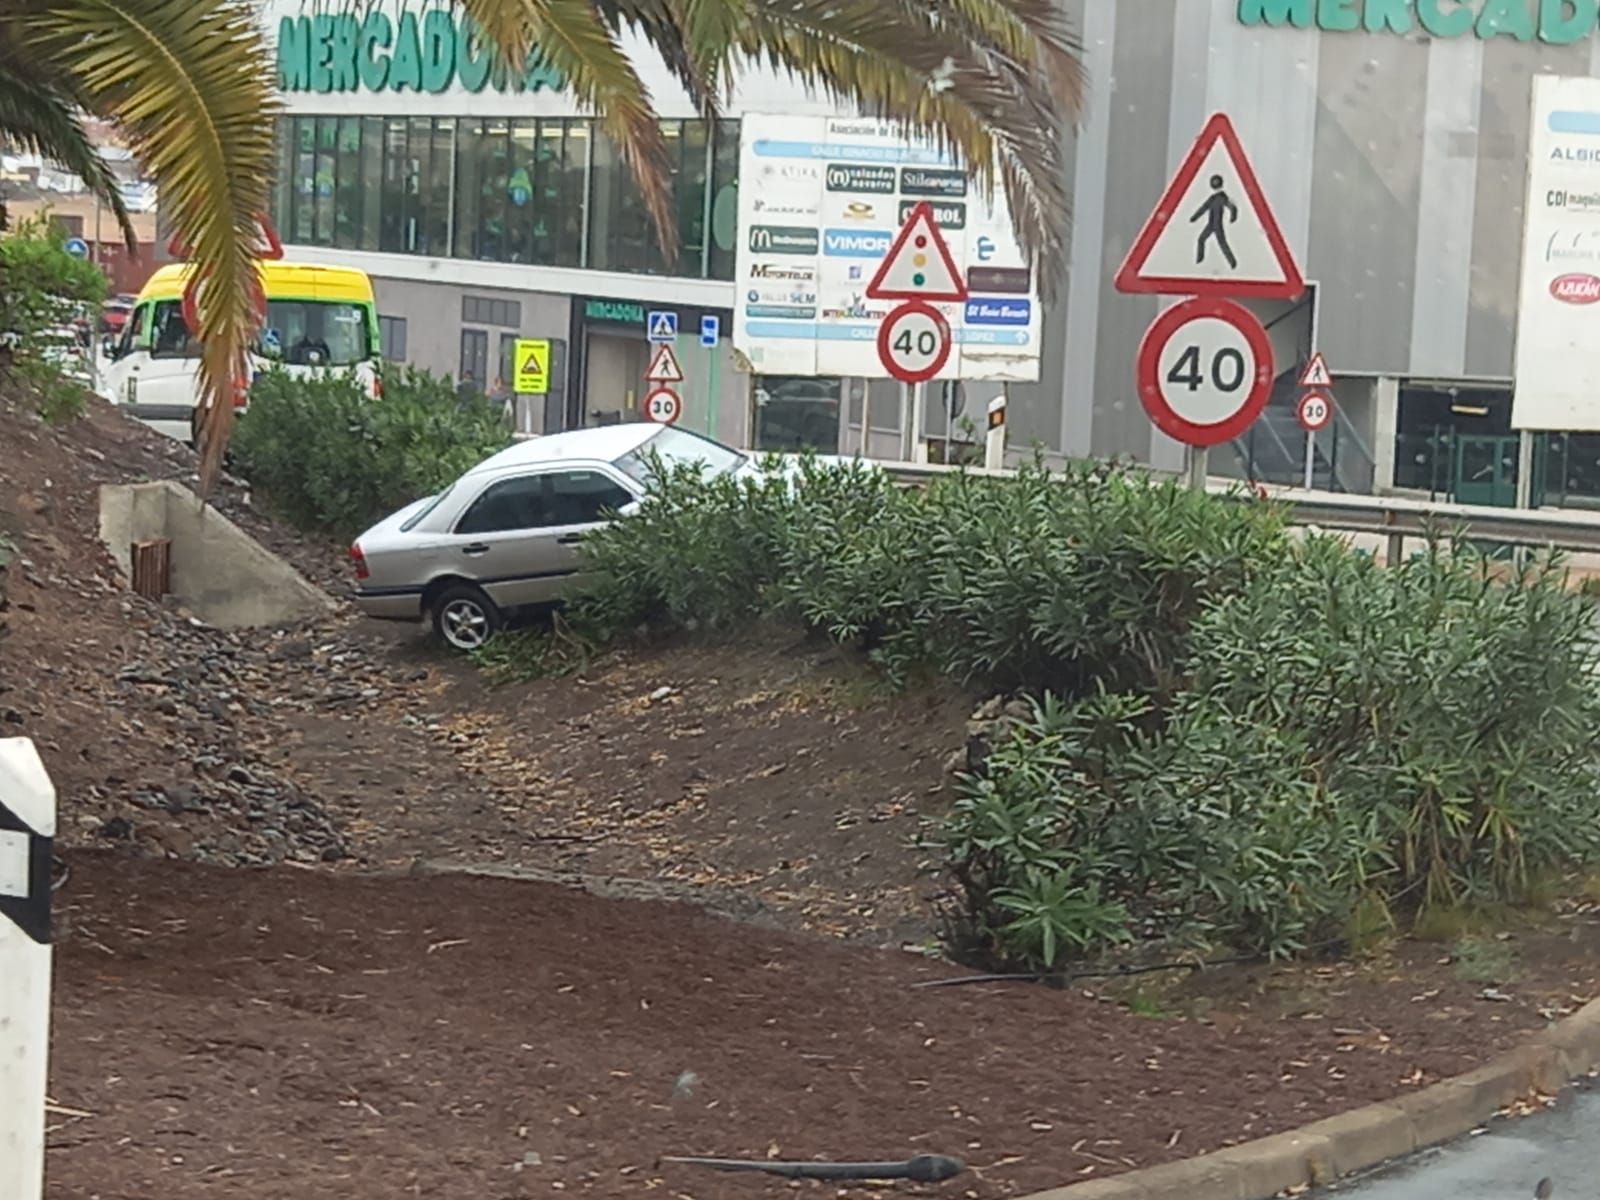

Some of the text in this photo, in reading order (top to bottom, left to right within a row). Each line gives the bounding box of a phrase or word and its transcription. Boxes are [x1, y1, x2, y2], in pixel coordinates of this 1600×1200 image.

[894, 330, 936, 356] 40
[1167, 345, 1246, 393] 40
[653, 401, 673, 413] 30
[1306, 404, 1325, 419] 30
